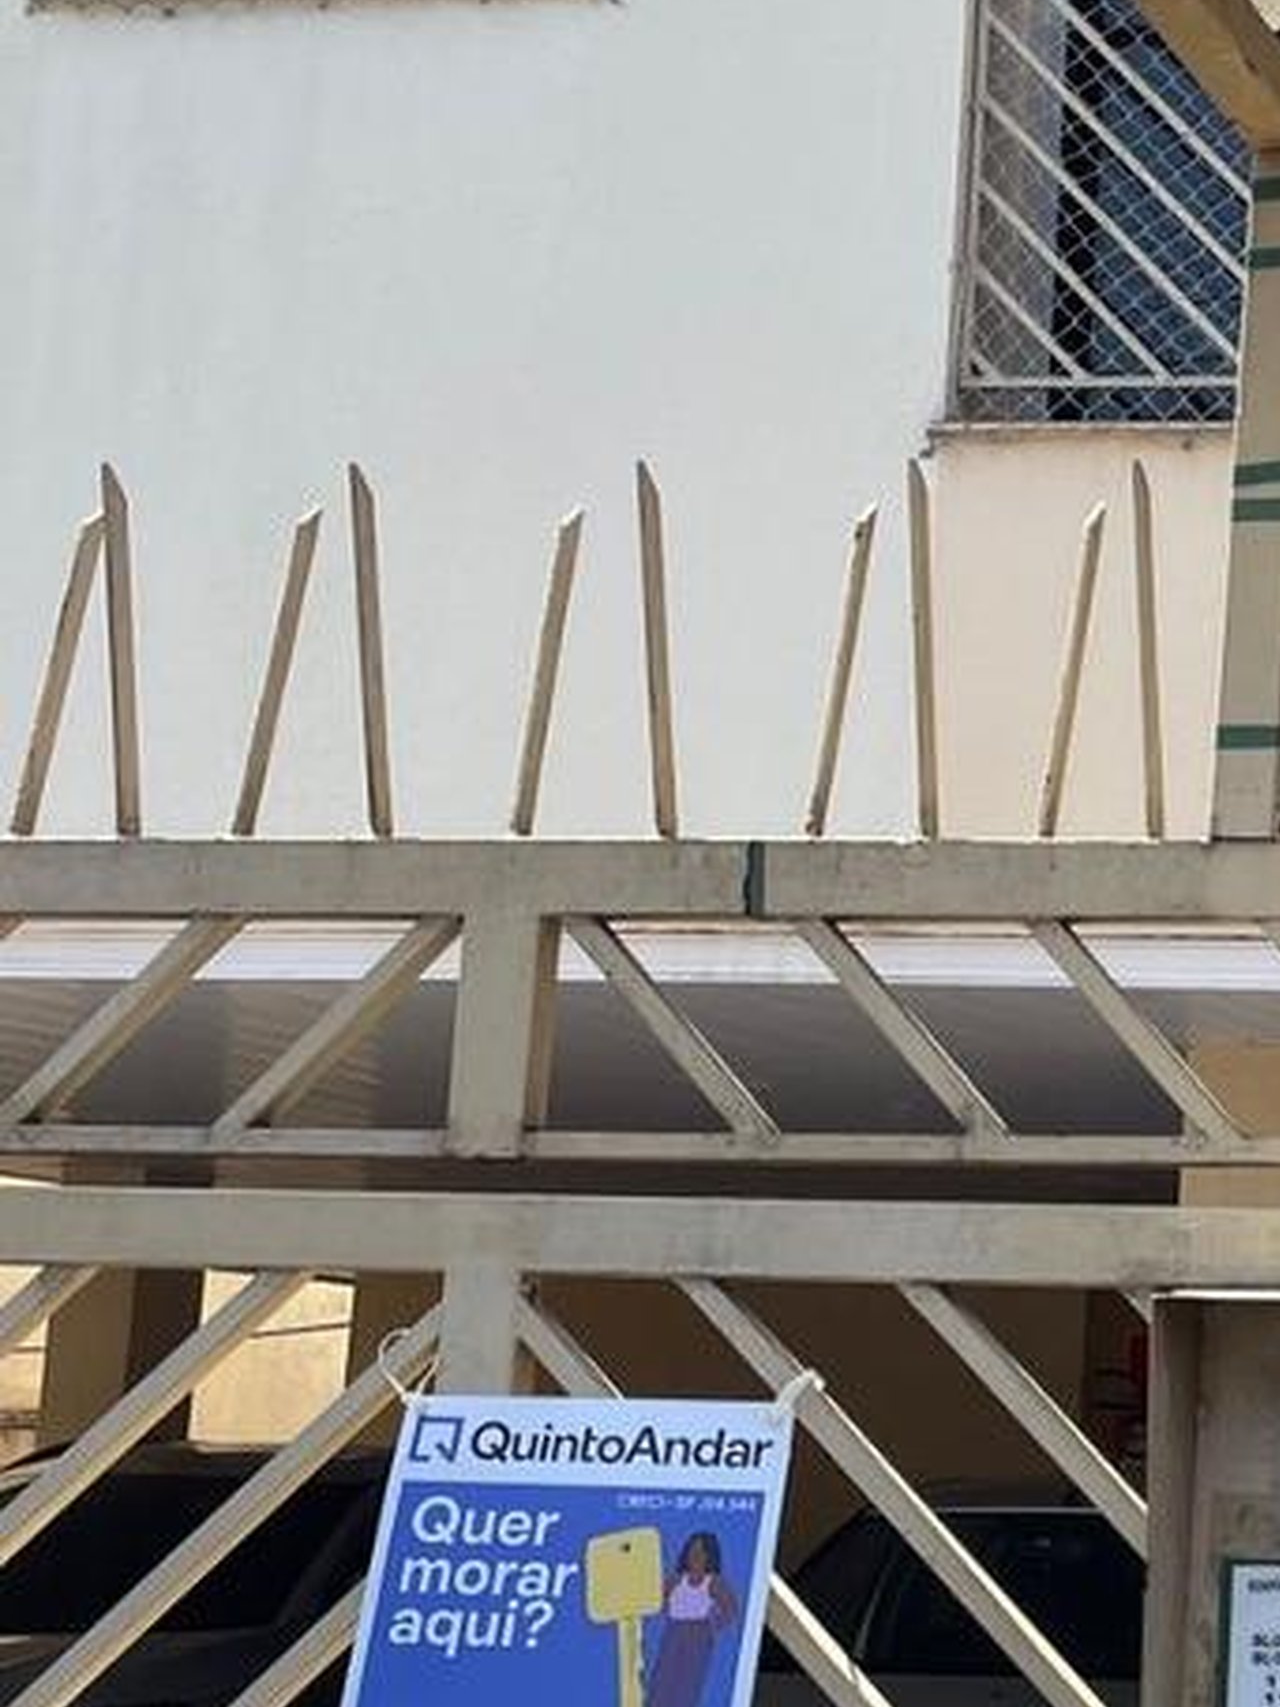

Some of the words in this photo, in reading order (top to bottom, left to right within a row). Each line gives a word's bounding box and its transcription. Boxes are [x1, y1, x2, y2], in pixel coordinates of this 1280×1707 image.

[470, 1420, 774, 1469] QuintoAndar
[412, 1496, 561, 1546] Quer
[400, 1558, 579, 1599] morar
[389, 1601, 555, 1658] aqui?
